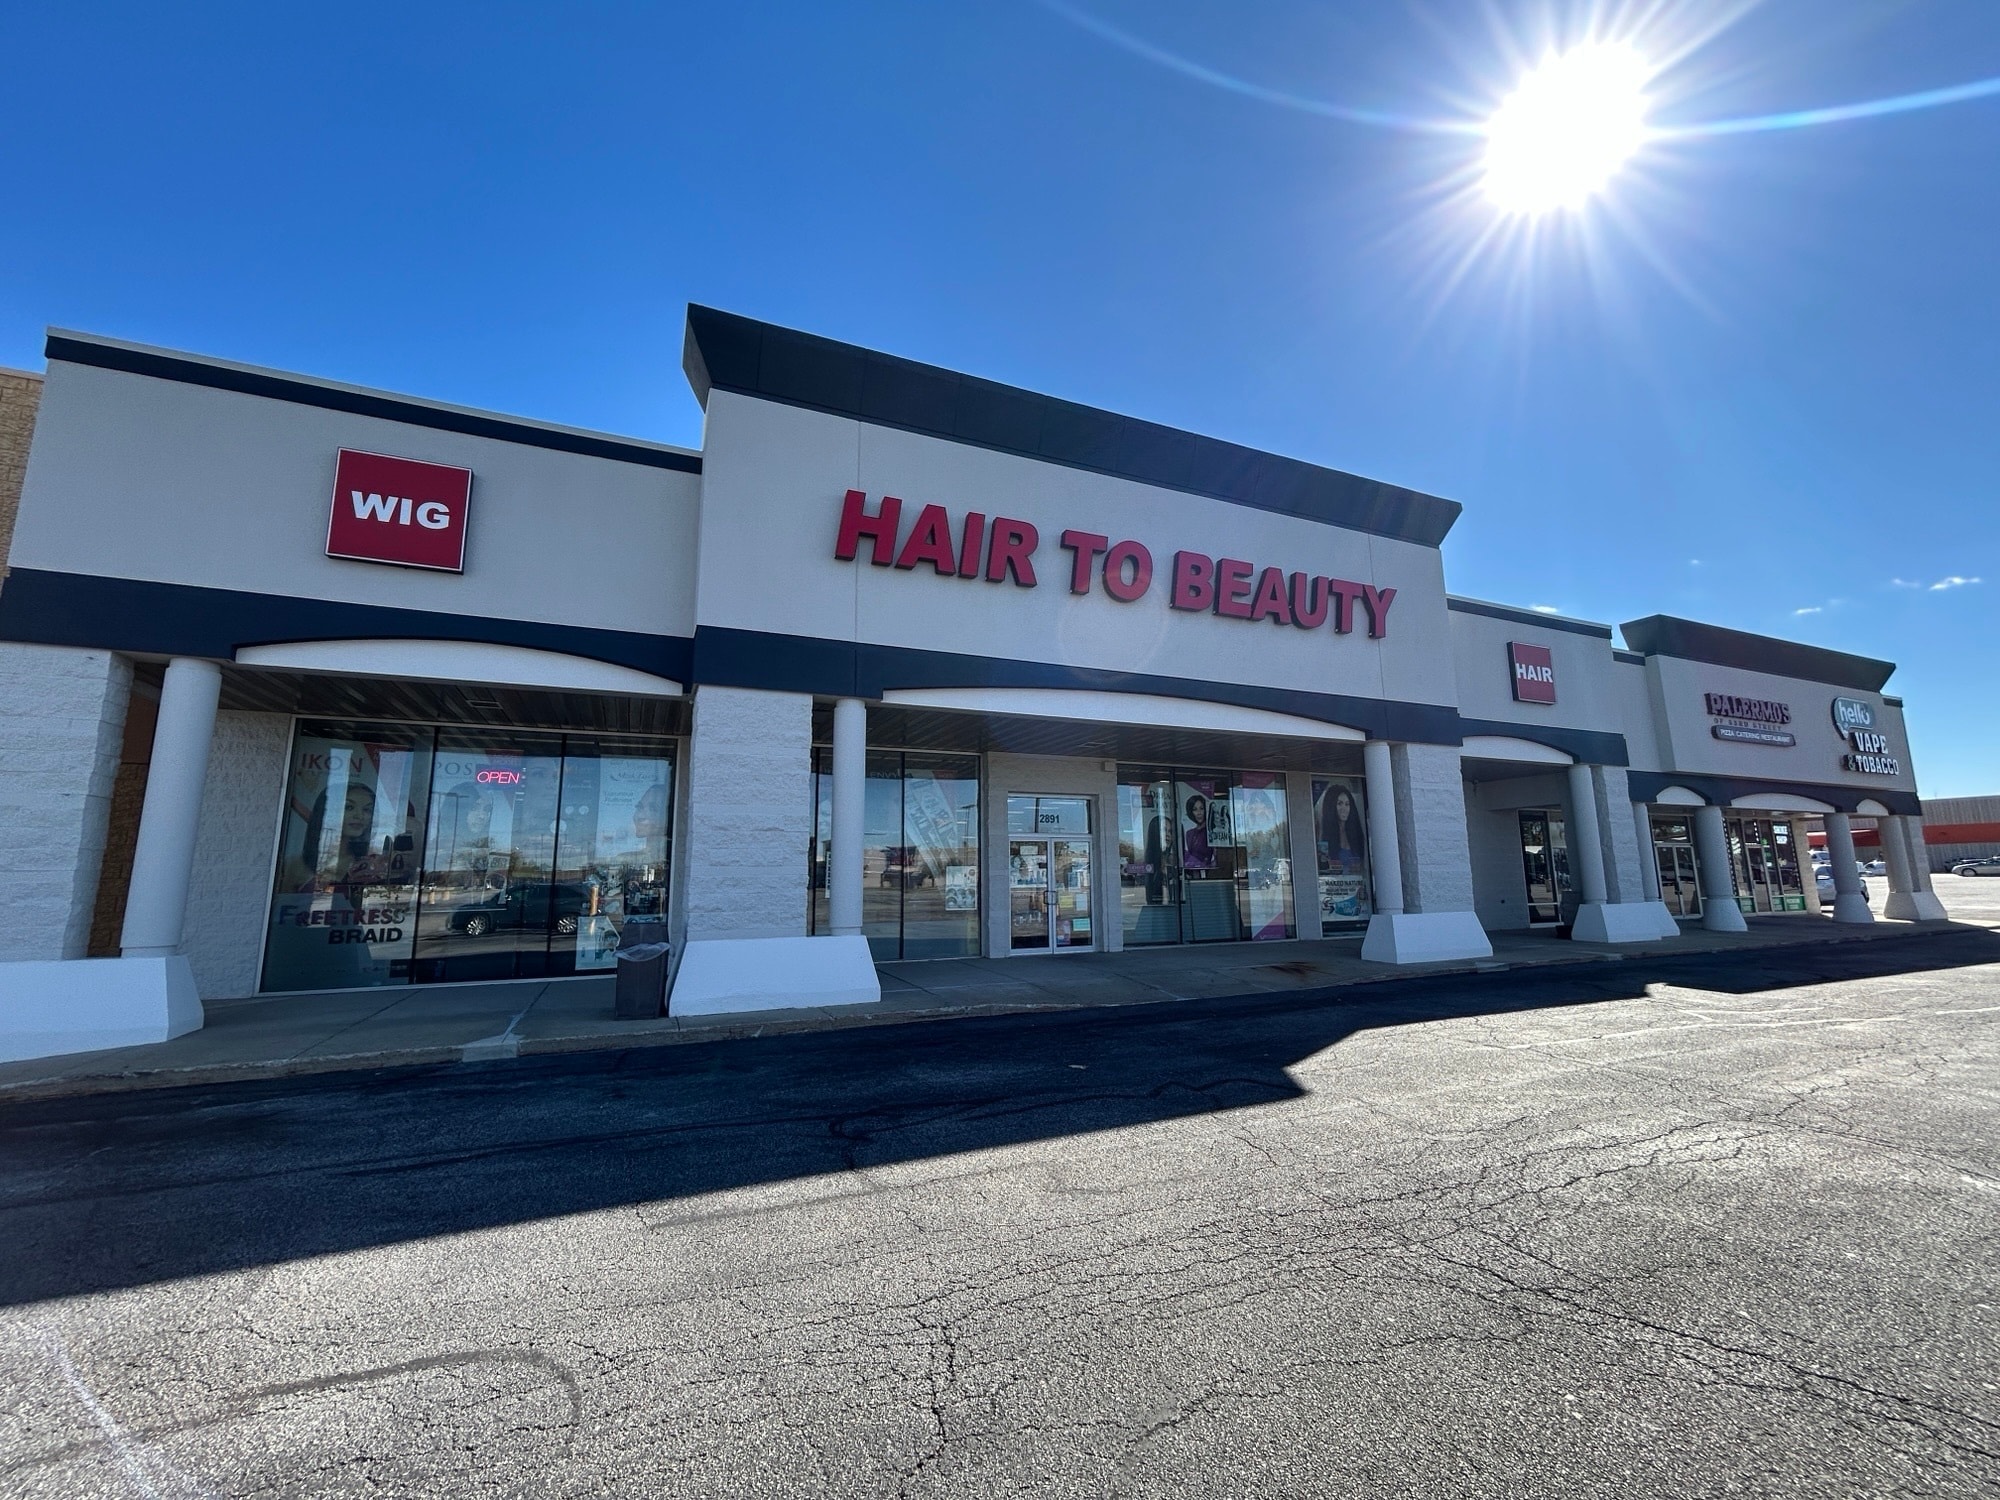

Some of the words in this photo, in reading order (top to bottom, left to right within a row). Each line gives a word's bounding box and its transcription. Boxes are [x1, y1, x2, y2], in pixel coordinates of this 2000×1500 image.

[351, 490, 450, 530] WIG
[835, 489, 1040, 588] HAIR
[1061, 528, 1154, 602] TO
[1170, 549, 1397, 639] BEAUTY
[1515, 662, 1554, 683] HAIR
[1838, 700, 1871, 725] hello
[1720, 729, 1735, 737] PIZZA
[1736, 731, 1760, 740] CATERING
[1854, 731, 1889, 754] VAPE
[301, 753, 363, 773] IKON
[1855, 755, 1900, 776] TOBACCO
[476, 771, 520, 784] OPEN
[1039, 813, 1060, 824] 2891
[328, 927, 404, 945] BRAID
